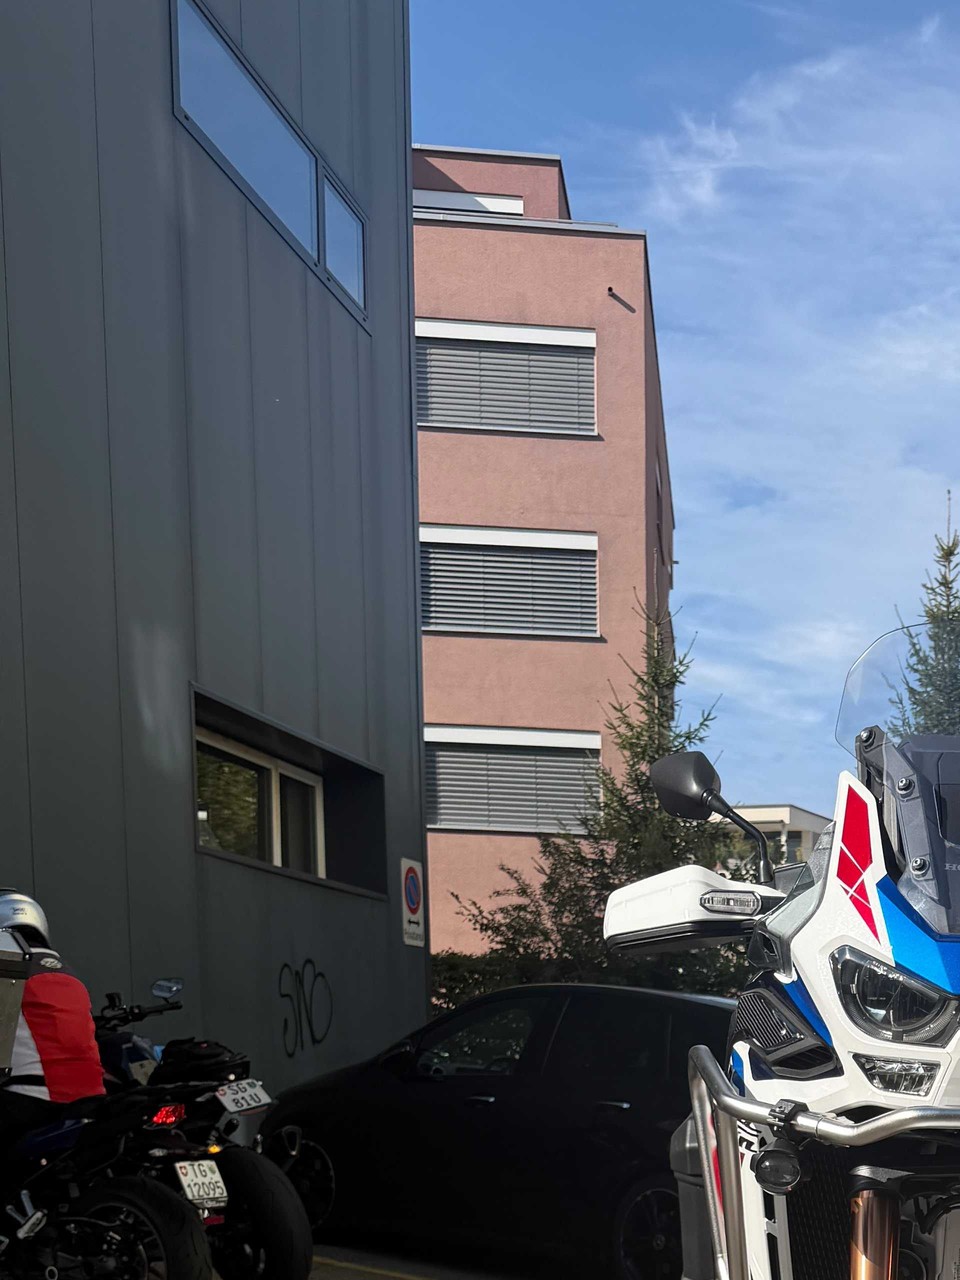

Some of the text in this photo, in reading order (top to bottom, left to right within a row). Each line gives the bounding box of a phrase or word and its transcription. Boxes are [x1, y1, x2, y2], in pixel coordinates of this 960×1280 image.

[227, 1082, 248, 1096] SG
[188, 1162, 208, 1178] TG
[186, 1180, 224, 1199] 12095
